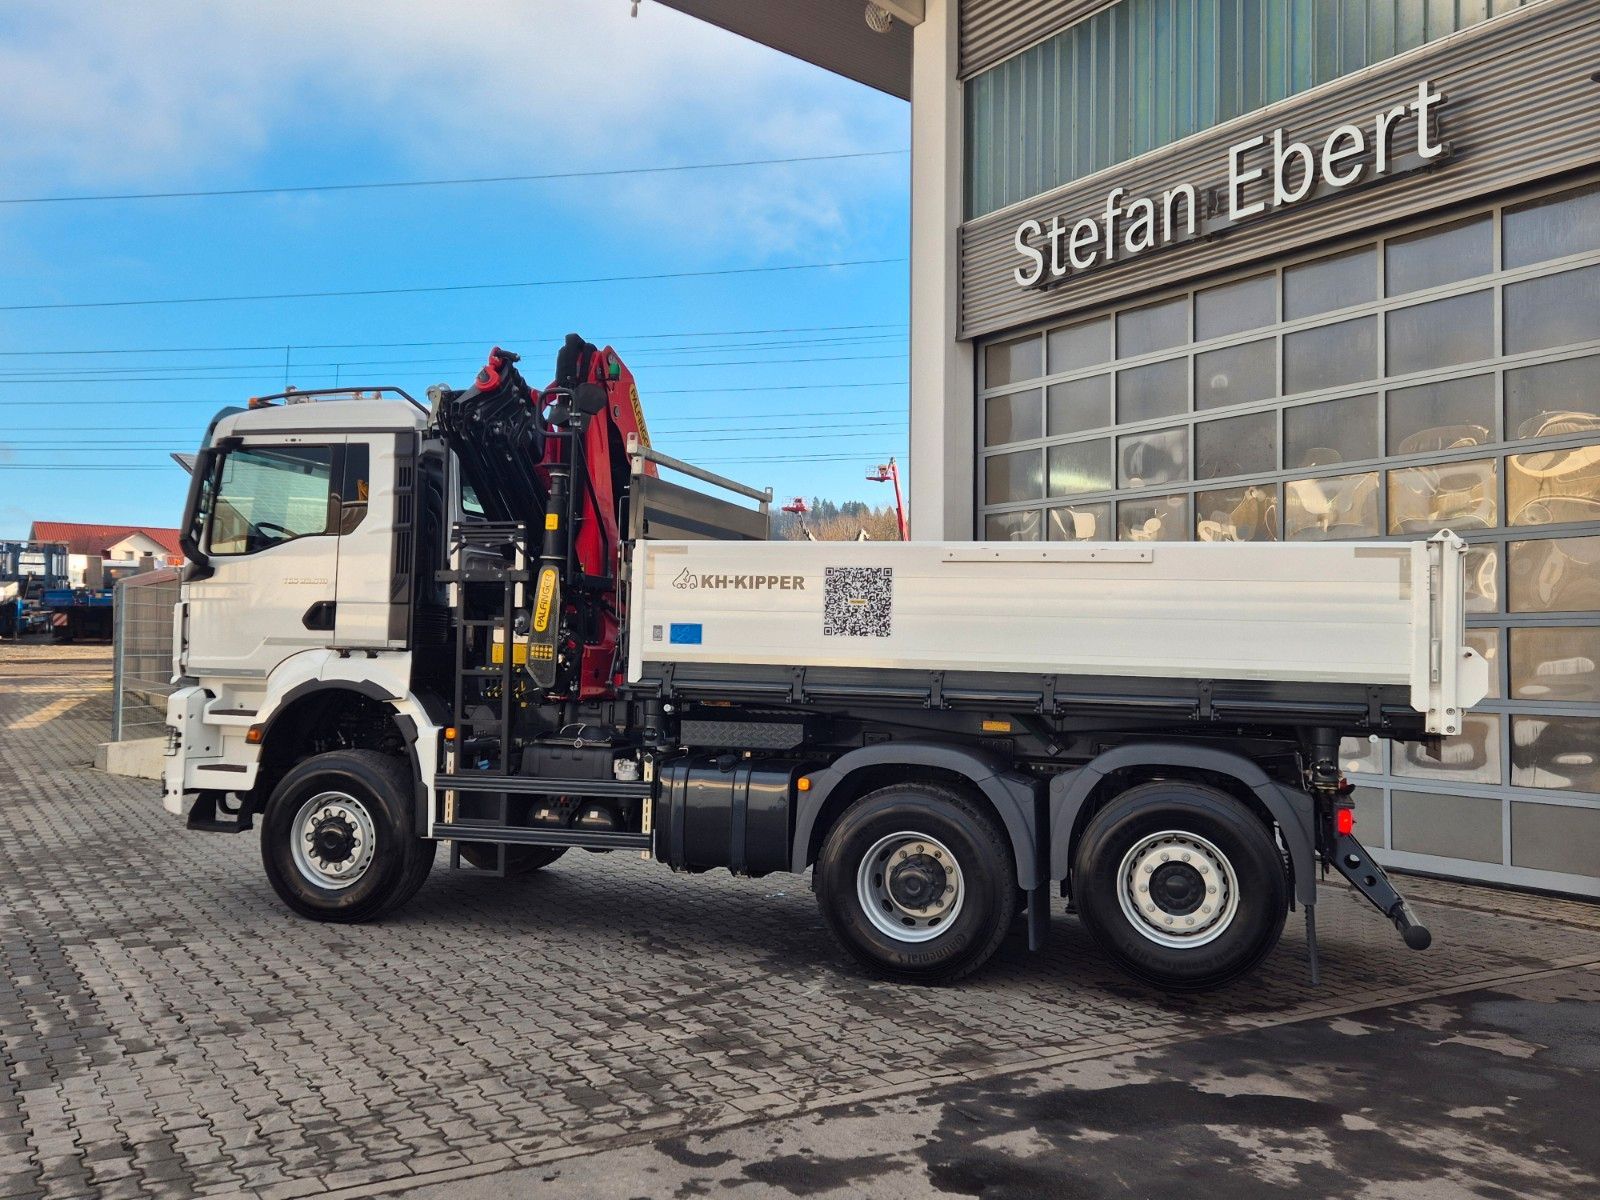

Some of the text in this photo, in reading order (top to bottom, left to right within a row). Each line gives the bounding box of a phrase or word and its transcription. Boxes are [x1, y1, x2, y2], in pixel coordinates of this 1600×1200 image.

[1014, 80, 1443, 287] Stefan Ebert
[629, 386, 650, 450] PALFINGE
[536, 573, 553, 628] PALFINGER
[701, 574, 805, 590] KH-KIPPER
